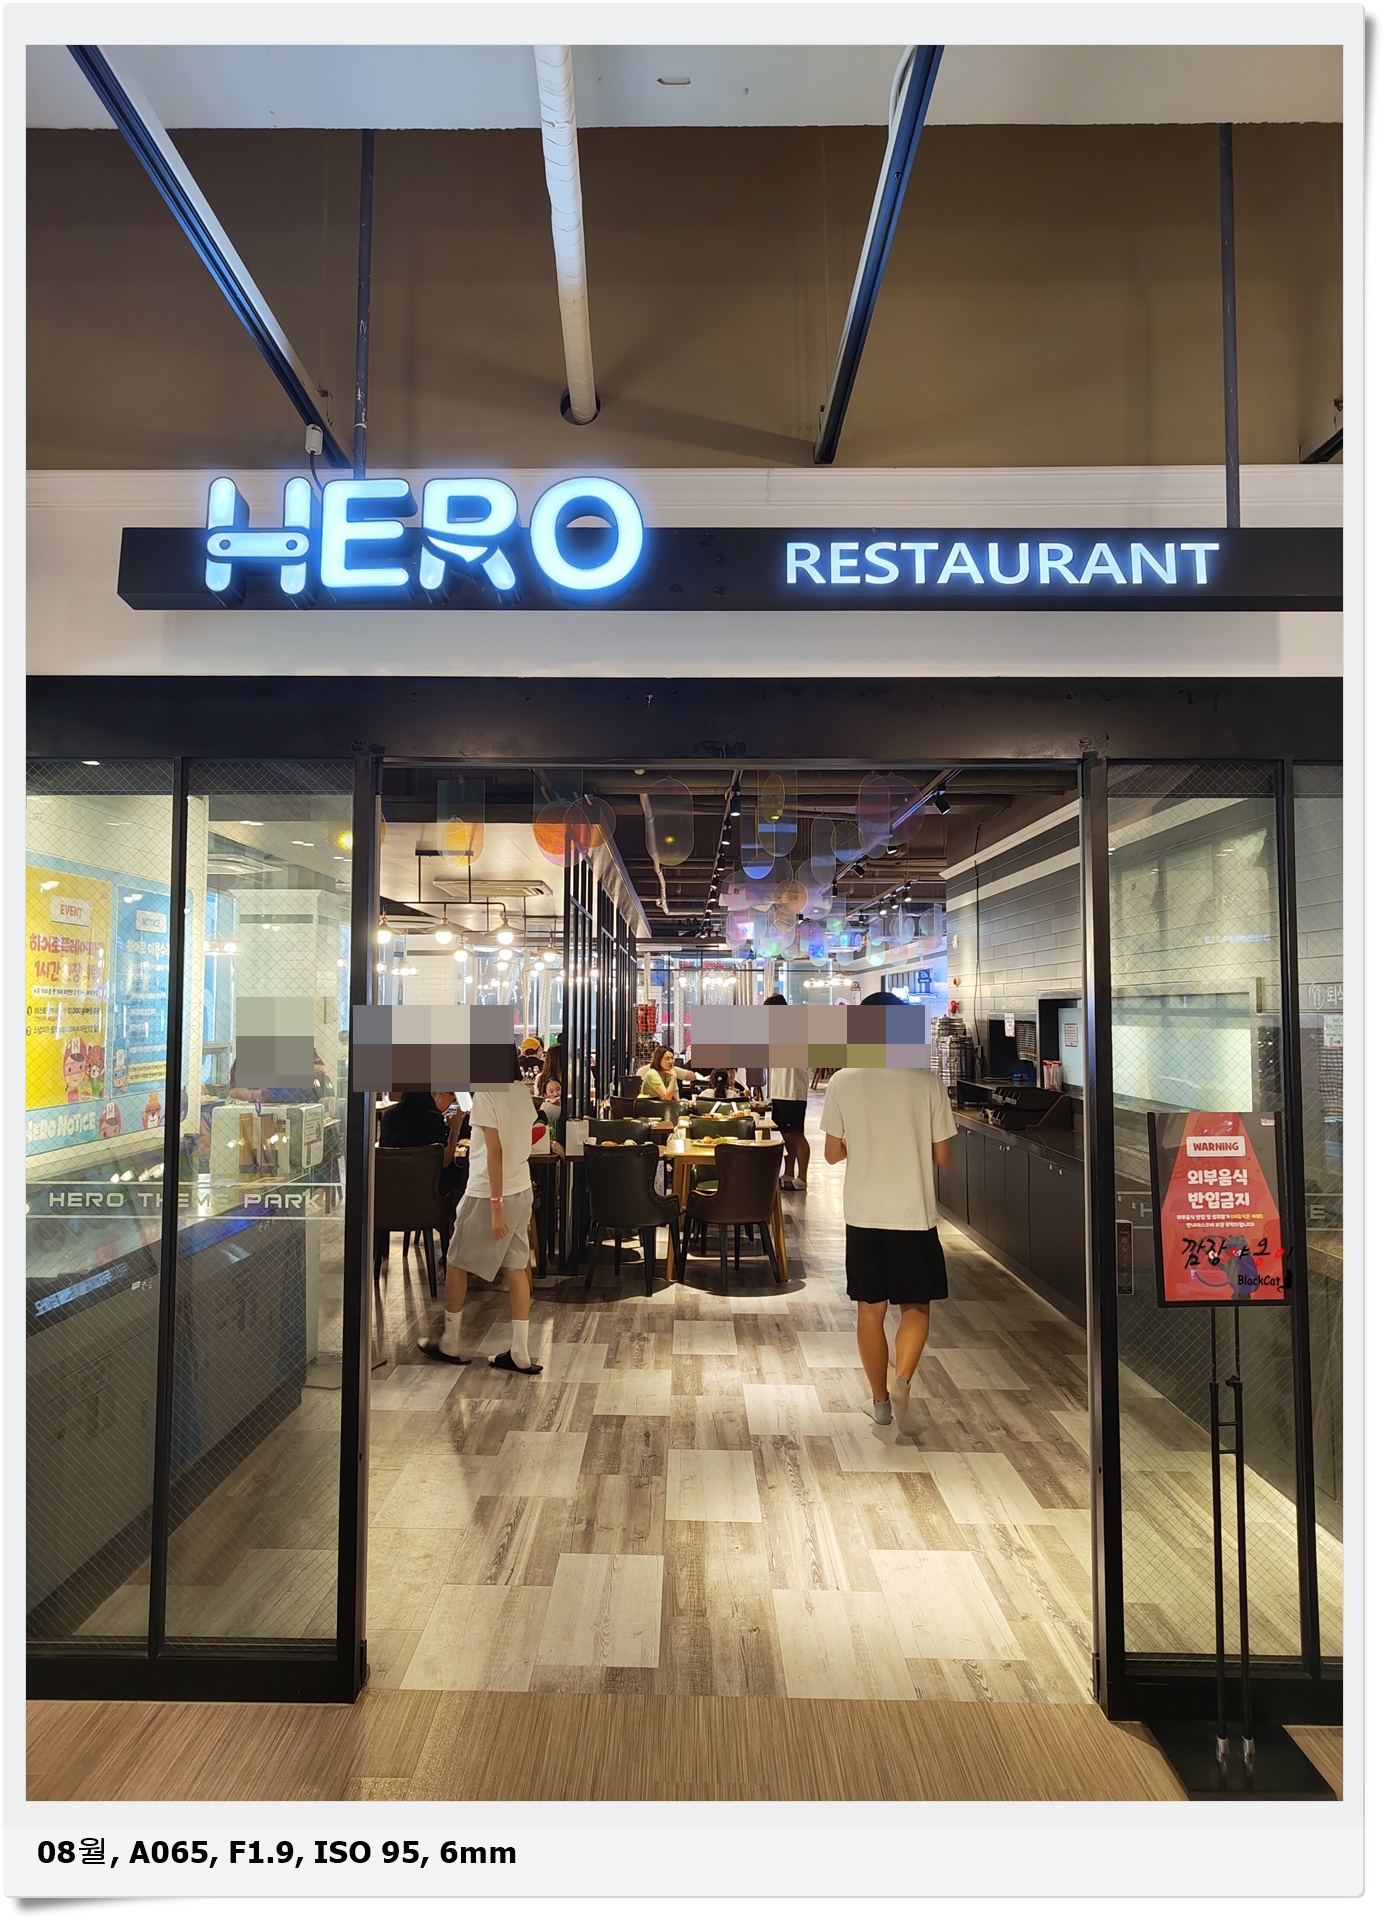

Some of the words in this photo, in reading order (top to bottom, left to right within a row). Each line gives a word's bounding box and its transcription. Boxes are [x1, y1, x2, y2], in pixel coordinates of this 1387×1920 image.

[205, 476, 645, 596] HERO
[785, 542, 1221, 586] RESTAURANT
[60, 904, 83, 918] EVENT
[141, 917, 161, 928] NOTICE
[26, 1119, 57, 1143] HERO
[57, 1111, 97, 1137] NOTICE
[1193, 1141, 1240, 1152] WARNING
[1187, 1168, 1248, 1187] 외부음식
[49, 1192, 124, 1208] HERO
[244, 1193, 322, 1210] PARK
[1187, 1191, 1250, 1210] 반입금지
